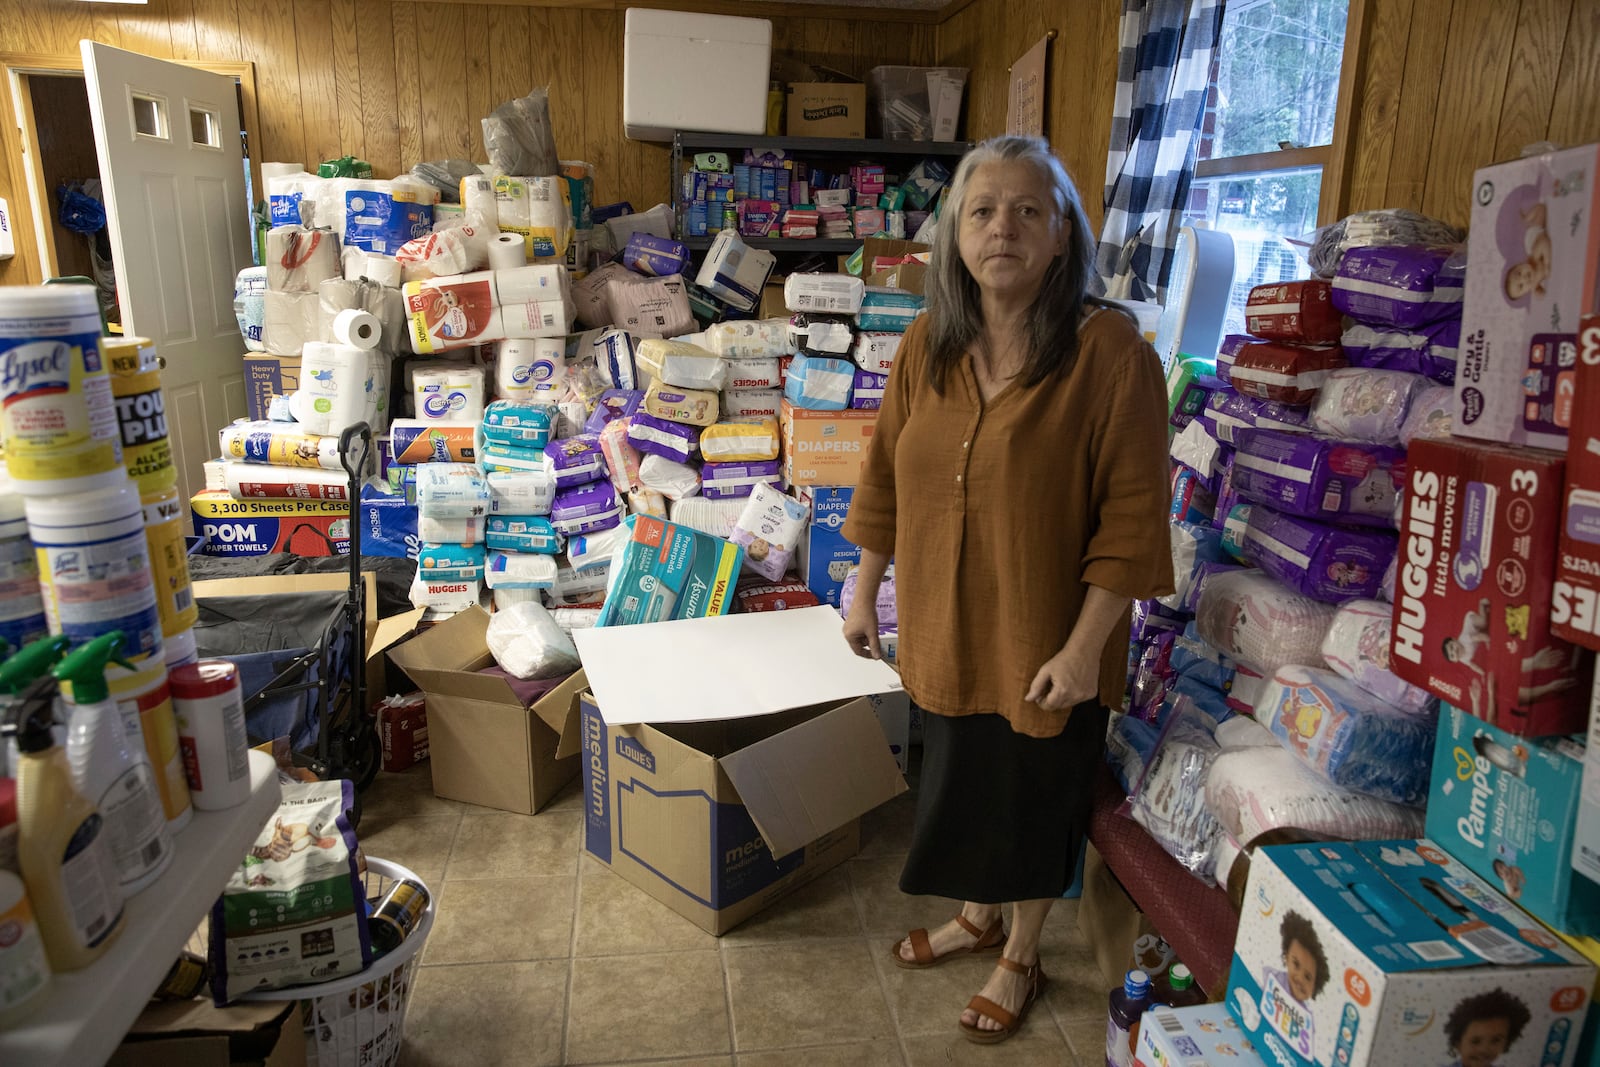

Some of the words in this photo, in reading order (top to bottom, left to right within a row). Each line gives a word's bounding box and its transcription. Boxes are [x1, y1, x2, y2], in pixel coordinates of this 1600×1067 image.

[1319, 290, 1326, 301] 2
[1290, 315, 1297, 326] 2
[1467, 334, 1475, 344] &
[1472, 329, 1485, 383] Gentle
[1, 341, 66, 392] Lysol
[112, 356, 137, 371] NEW
[1463, 350, 1475, 378] Dry
[251, 365, 275, 375] Heavy
[252, 372, 271, 381] Duty
[733, 379, 769, 387] HUGGIES
[657, 407, 690, 419] cuties
[740, 409, 775, 417] HUGGIES
[797, 441, 861, 453] DIAPERS
[136, 454, 156, 466] ALL
[797, 470, 817, 479] 100
[1511, 469, 1538, 496] 3
[210, 503, 247, 515] 3,300
[250, 502, 294, 513] Sheets
[297, 502, 318, 512] Per
[320, 501, 349, 512] Case
[817, 502, 850, 511] DIAPERS
[1441, 476, 1457, 548] movers
[829, 514, 837, 525] 6
[203, 524, 257, 543] POM
[651, 528, 659, 538] XL
[233, 543, 268, 552] TOWELS
[666, 533, 682, 574] underpads
[676, 535, 691, 570] Premium
[1395, 470, 1439, 665] HUGGIES
[1434, 550, 1450, 598] little
[428, 584, 468, 594] HUGGIES
[645, 577, 654, 590] 30
[709, 580, 726, 614] VALUE
[738, 585, 810, 598] HUGGIES
[400, 719, 409, 730] 2
[588, 714, 605, 818] medium
[1264, 991, 1310, 1055] STEPS
